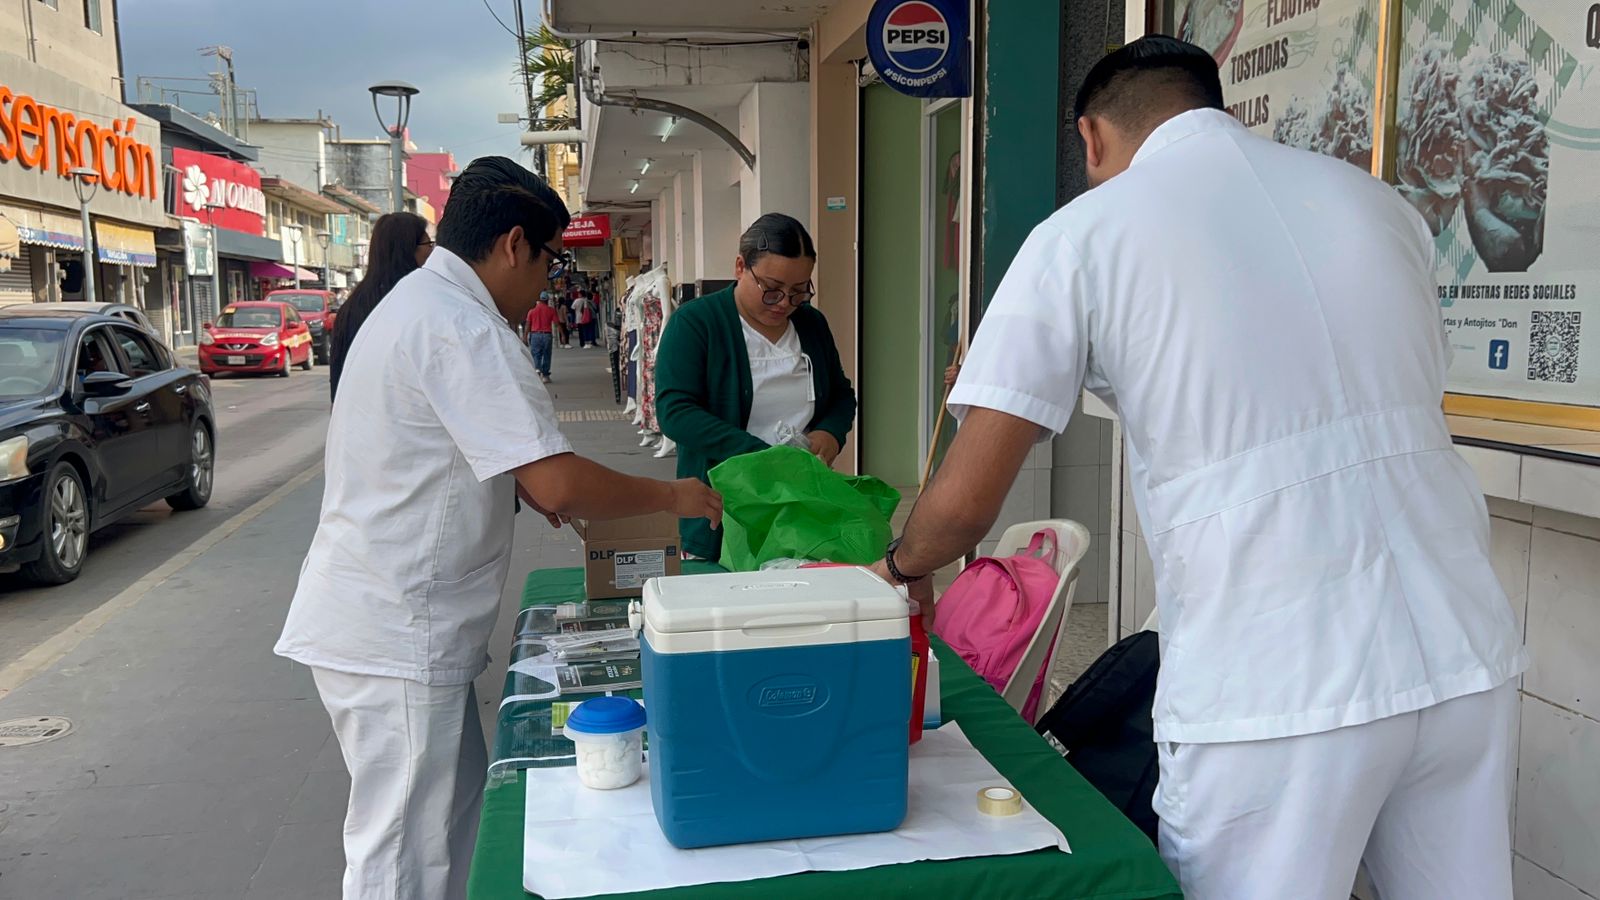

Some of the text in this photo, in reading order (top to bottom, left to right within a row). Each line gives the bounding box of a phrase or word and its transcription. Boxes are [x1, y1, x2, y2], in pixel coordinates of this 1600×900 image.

[1266, 0, 1320, 28] FLAUT
[887, 29, 945, 44] PEPSI
[1230, 37, 1289, 85] TOSTADAS
[0, 85, 156, 201] sensación
[567, 221, 595, 229] CEJA
[1450, 285, 1458, 299] EN
[1461, 285, 1500, 299] NUESTRAS
[1503, 285, 1530, 299] REDES
[1533, 284, 1576, 299] SOCIALES
[1464, 317, 1496, 329] Antojitos
[590, 550, 616, 560] DLP
[617, 556, 633, 564] DLP
